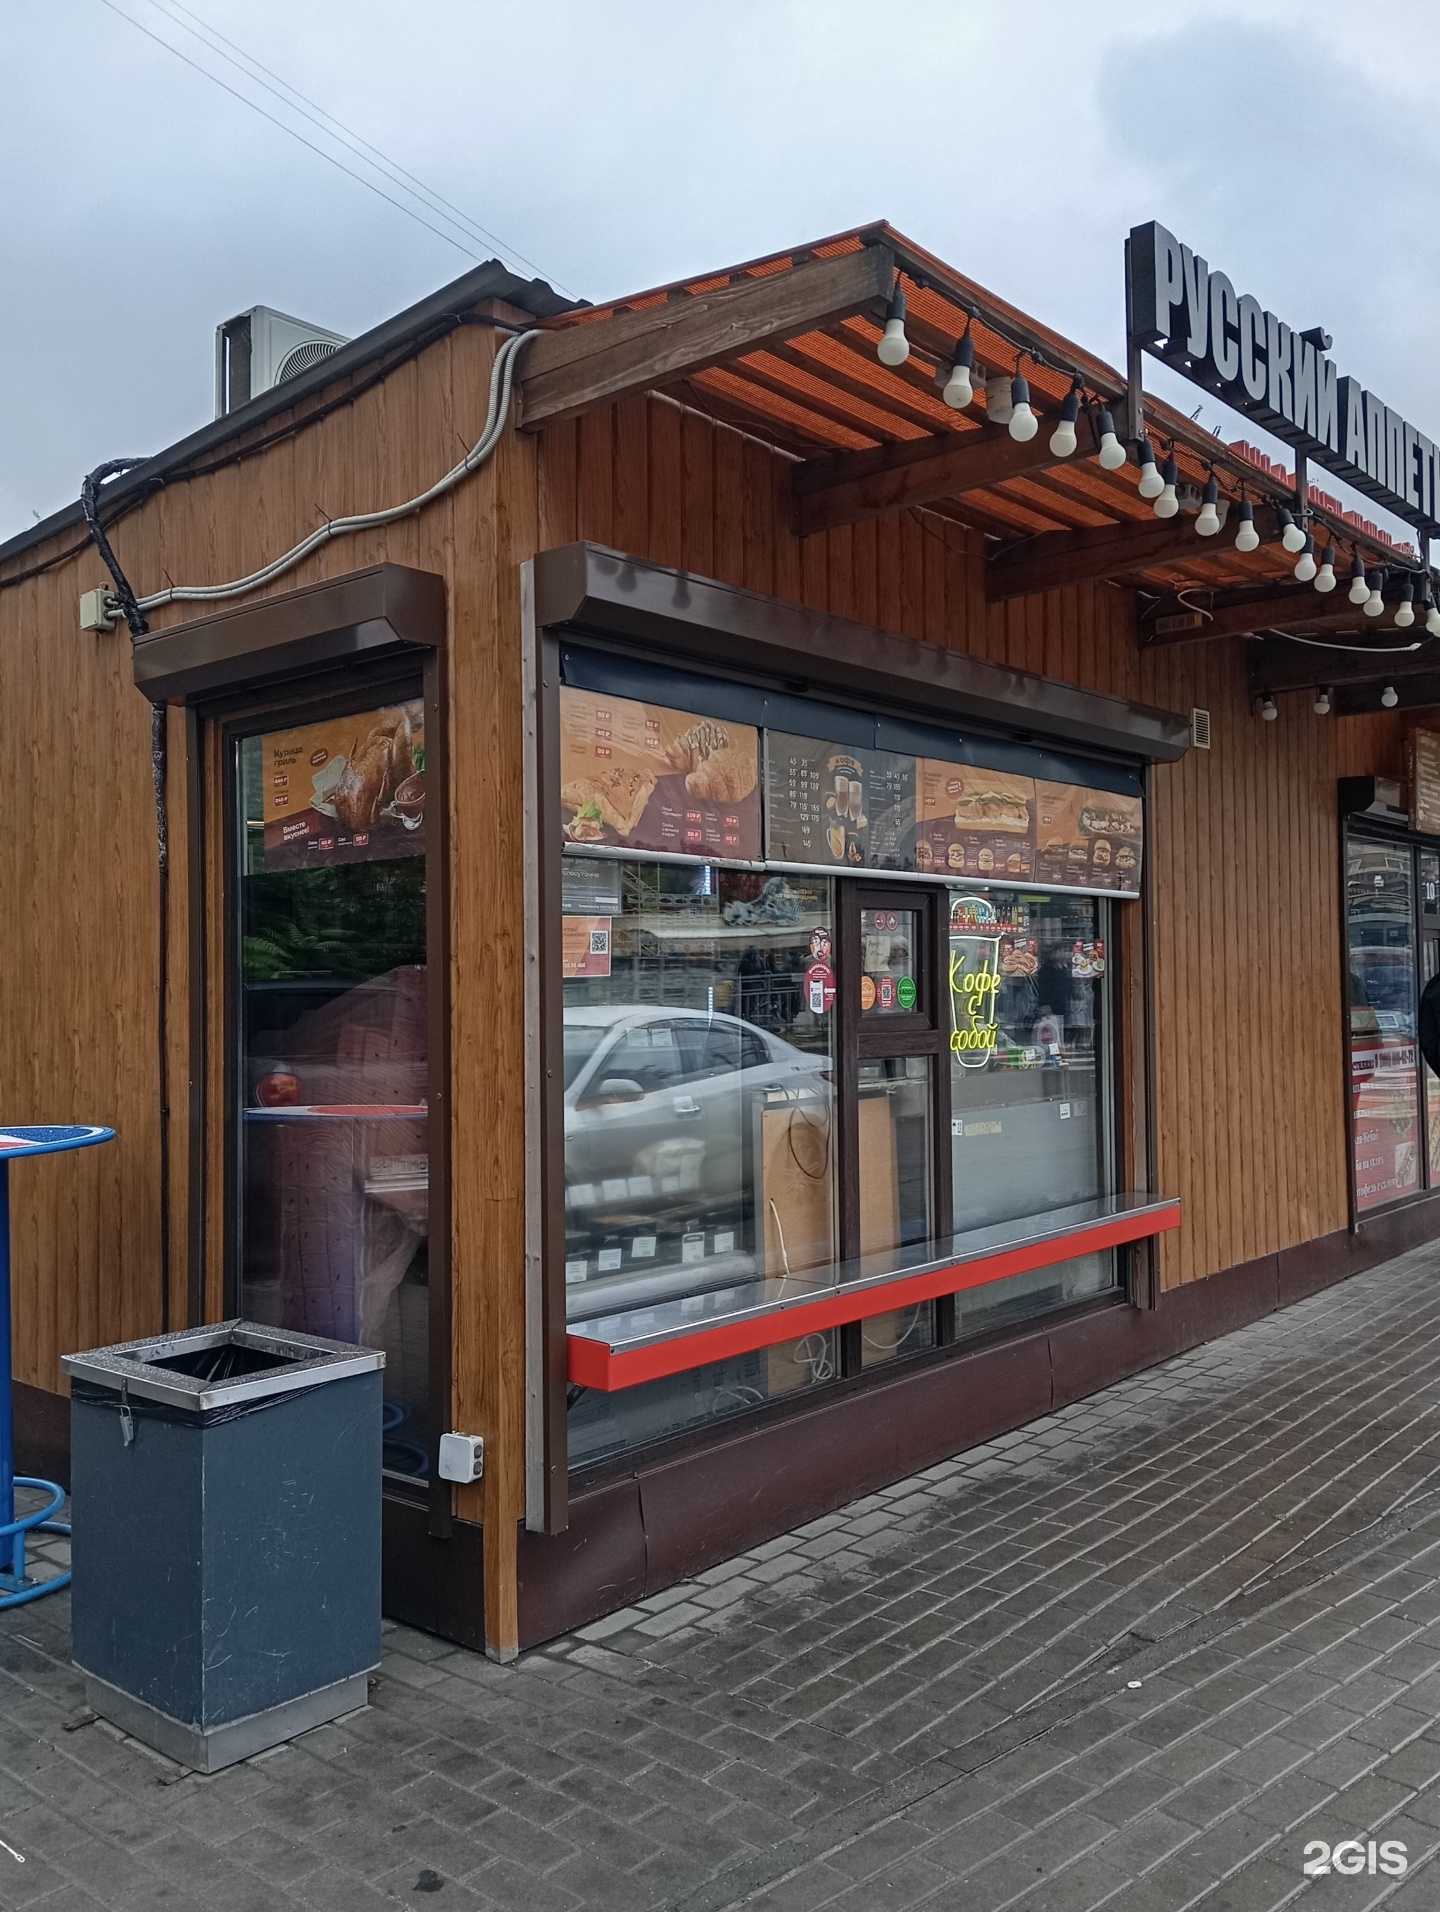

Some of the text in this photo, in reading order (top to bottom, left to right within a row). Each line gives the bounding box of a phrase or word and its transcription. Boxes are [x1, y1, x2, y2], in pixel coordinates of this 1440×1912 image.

[1153, 219, 1339, 455] РУССКИЙ
[949, 950, 1001, 1006] Кофе
[967, 995, 978, 1015] с
[949, 1015, 998, 1051] собой
